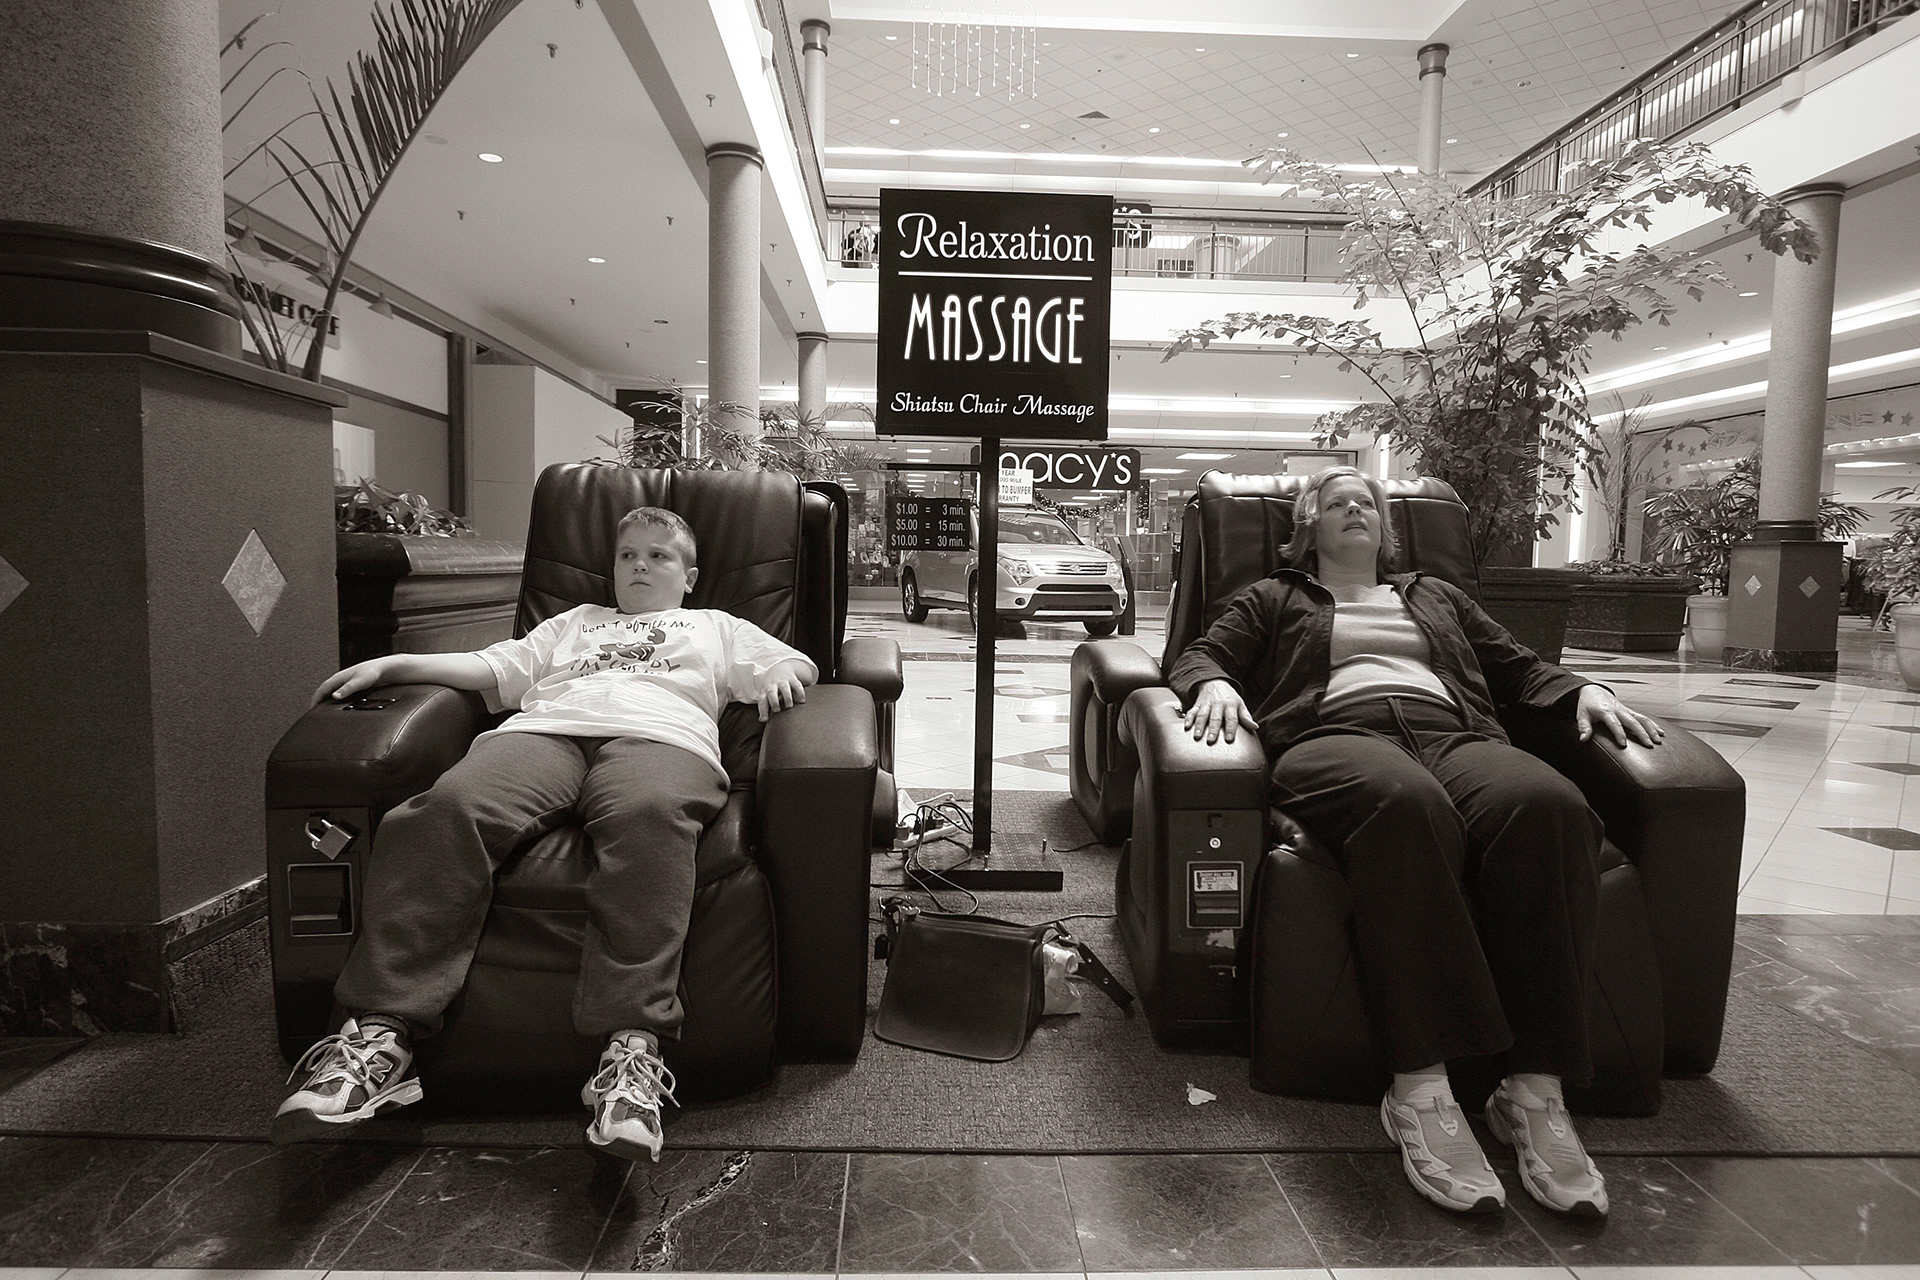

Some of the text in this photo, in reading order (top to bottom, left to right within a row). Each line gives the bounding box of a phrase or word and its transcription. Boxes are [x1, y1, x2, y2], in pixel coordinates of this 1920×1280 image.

[897, 213, 1095, 262] Relaxation
[904, 293, 1085, 364] MASSAGE
[891, 392, 1095, 423] Shiatsu Chair Massage
[1001, 469, 1016, 477] YEAR
[896, 502, 918, 515] $1.00
[942, 504, 948, 516] 3
[949, 504, 966, 516] min.
[896, 518, 918, 531] $5.00
[938, 520, 948, 531] 15
[949, 520, 966, 531] min.
[891, 534, 918, 546] $10.00
[937, 535, 948, 547] 30
[948, 535, 966, 547] min.
